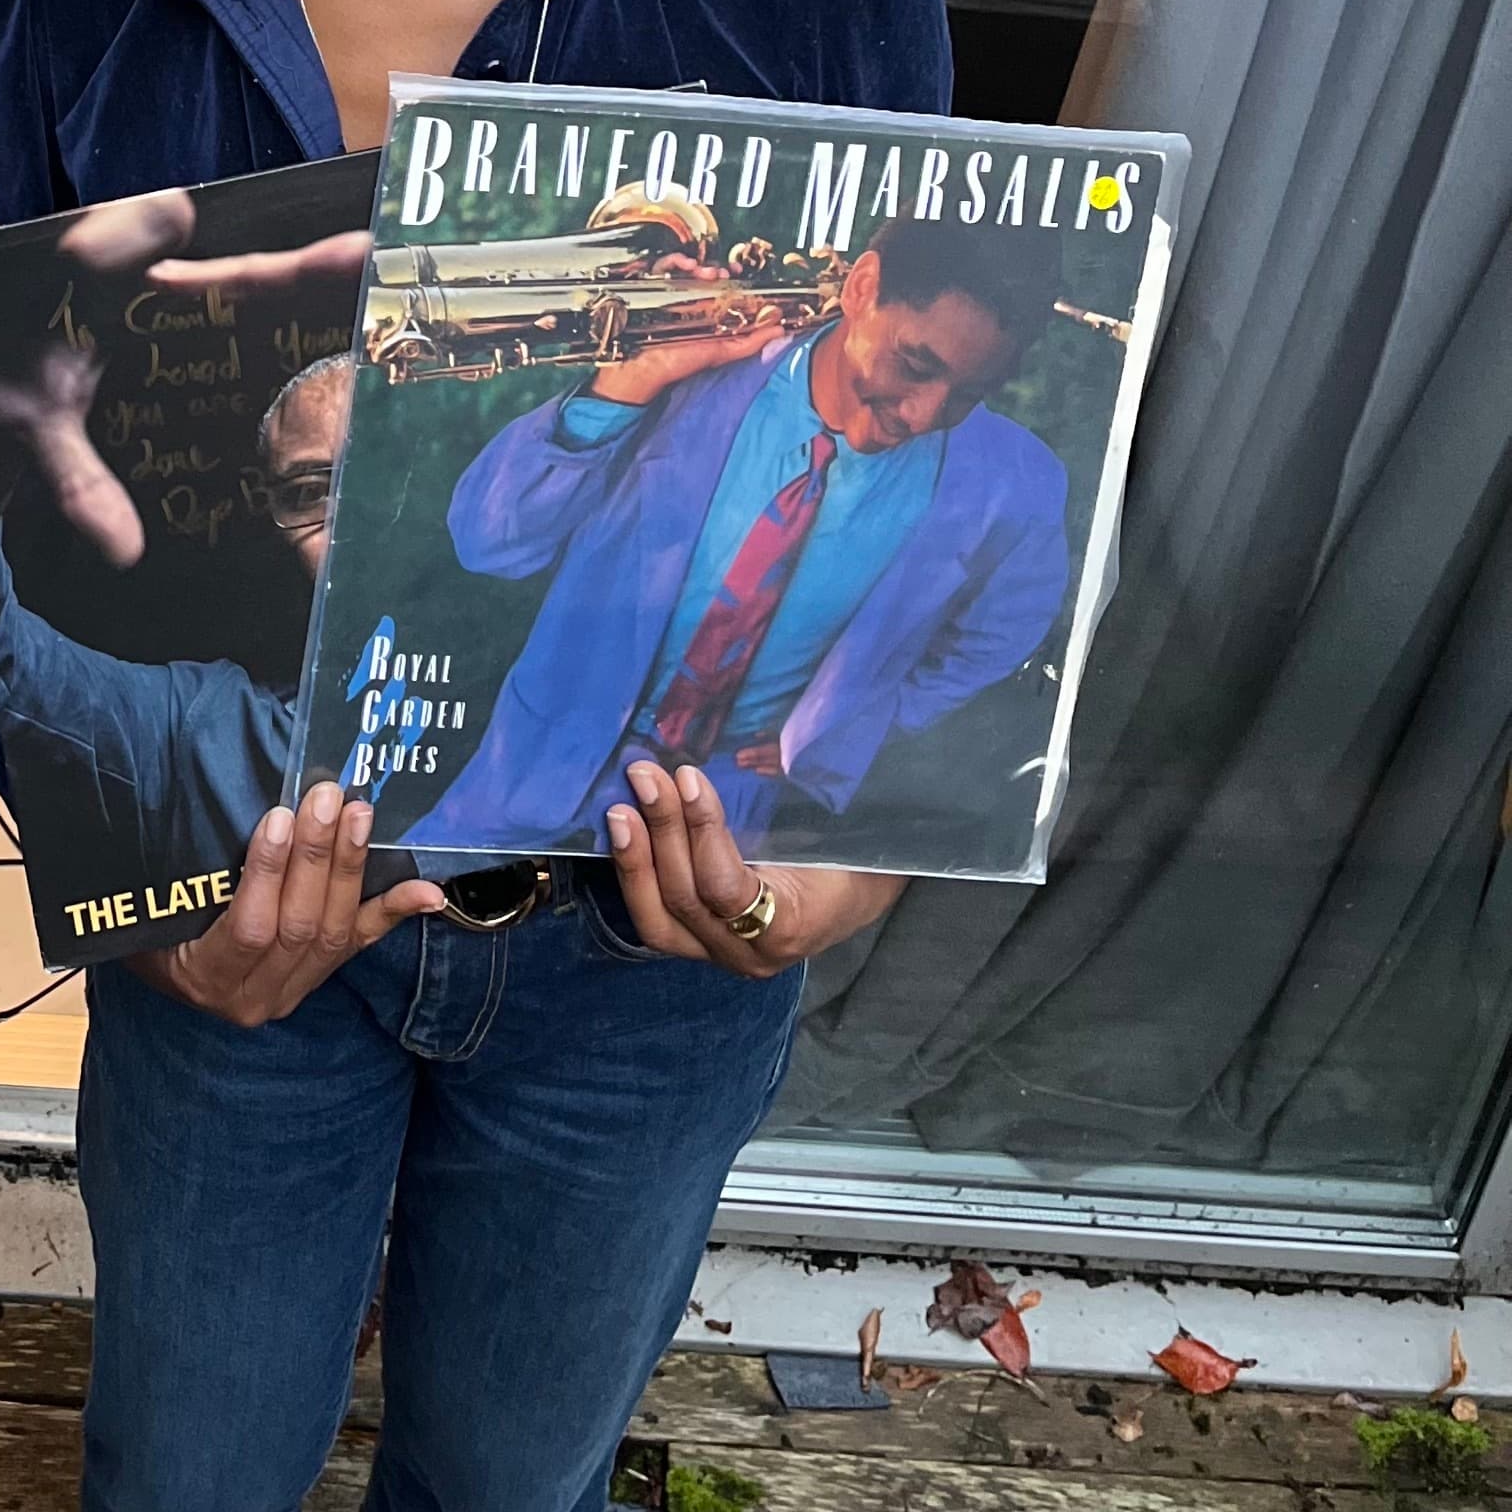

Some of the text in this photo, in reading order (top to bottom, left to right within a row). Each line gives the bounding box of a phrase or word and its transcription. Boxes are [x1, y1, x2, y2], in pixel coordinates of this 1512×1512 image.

[400, 116, 1140, 253] BRANFORD MARSALIS
[369, 636, 451, 683] ROYAL
[362, 690, 465, 734] GARDEN
[352, 743, 438, 786] BLUES
[64, 869, 233, 937] THE LATE
